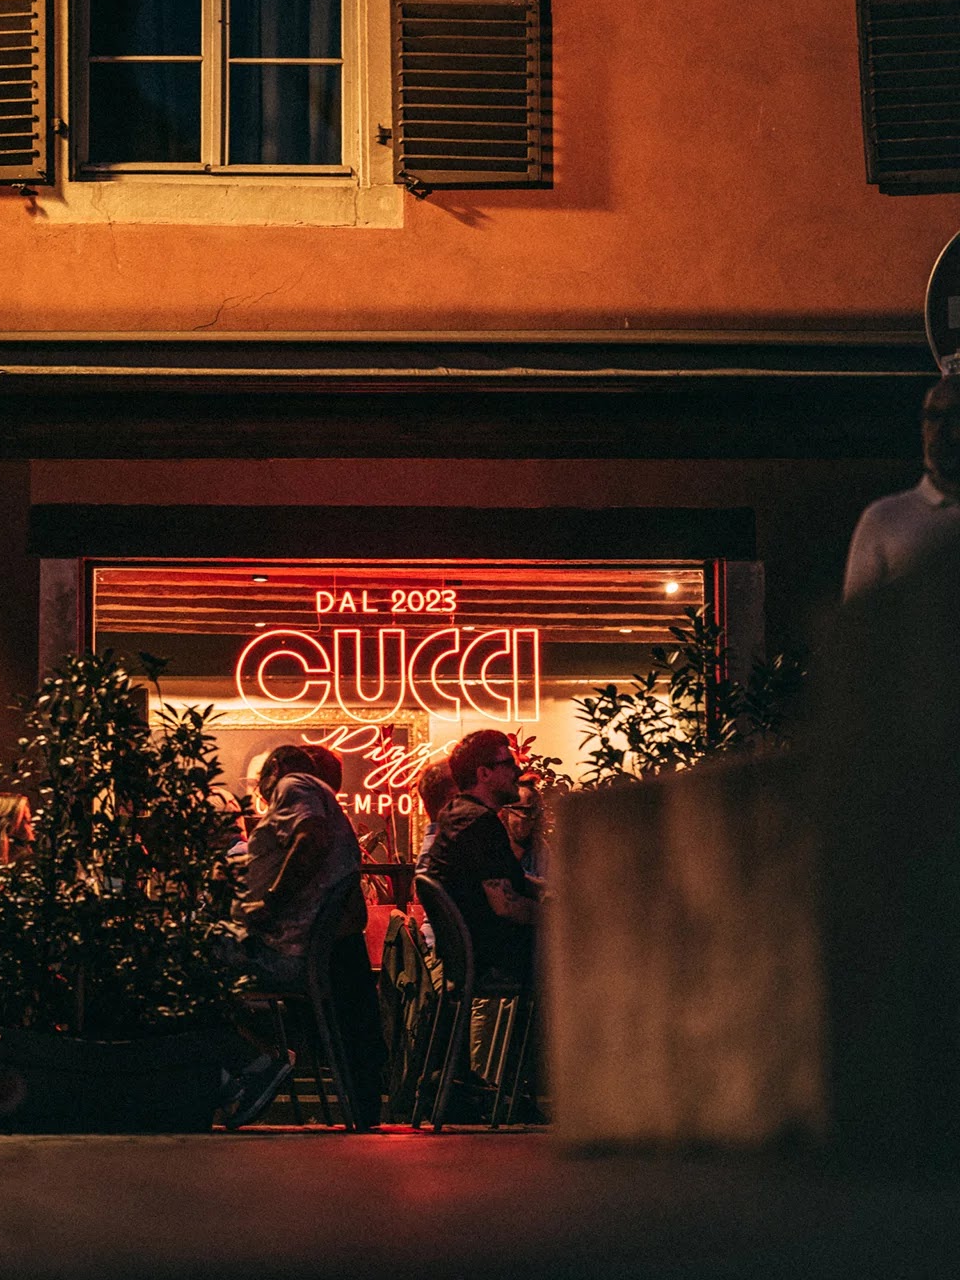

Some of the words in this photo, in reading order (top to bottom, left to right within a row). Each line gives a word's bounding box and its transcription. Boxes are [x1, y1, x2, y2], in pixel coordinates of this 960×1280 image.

[315, 590, 378, 613] DAL
[390, 589, 458, 613] 2023
[236, 627, 539, 722] CUCCI
